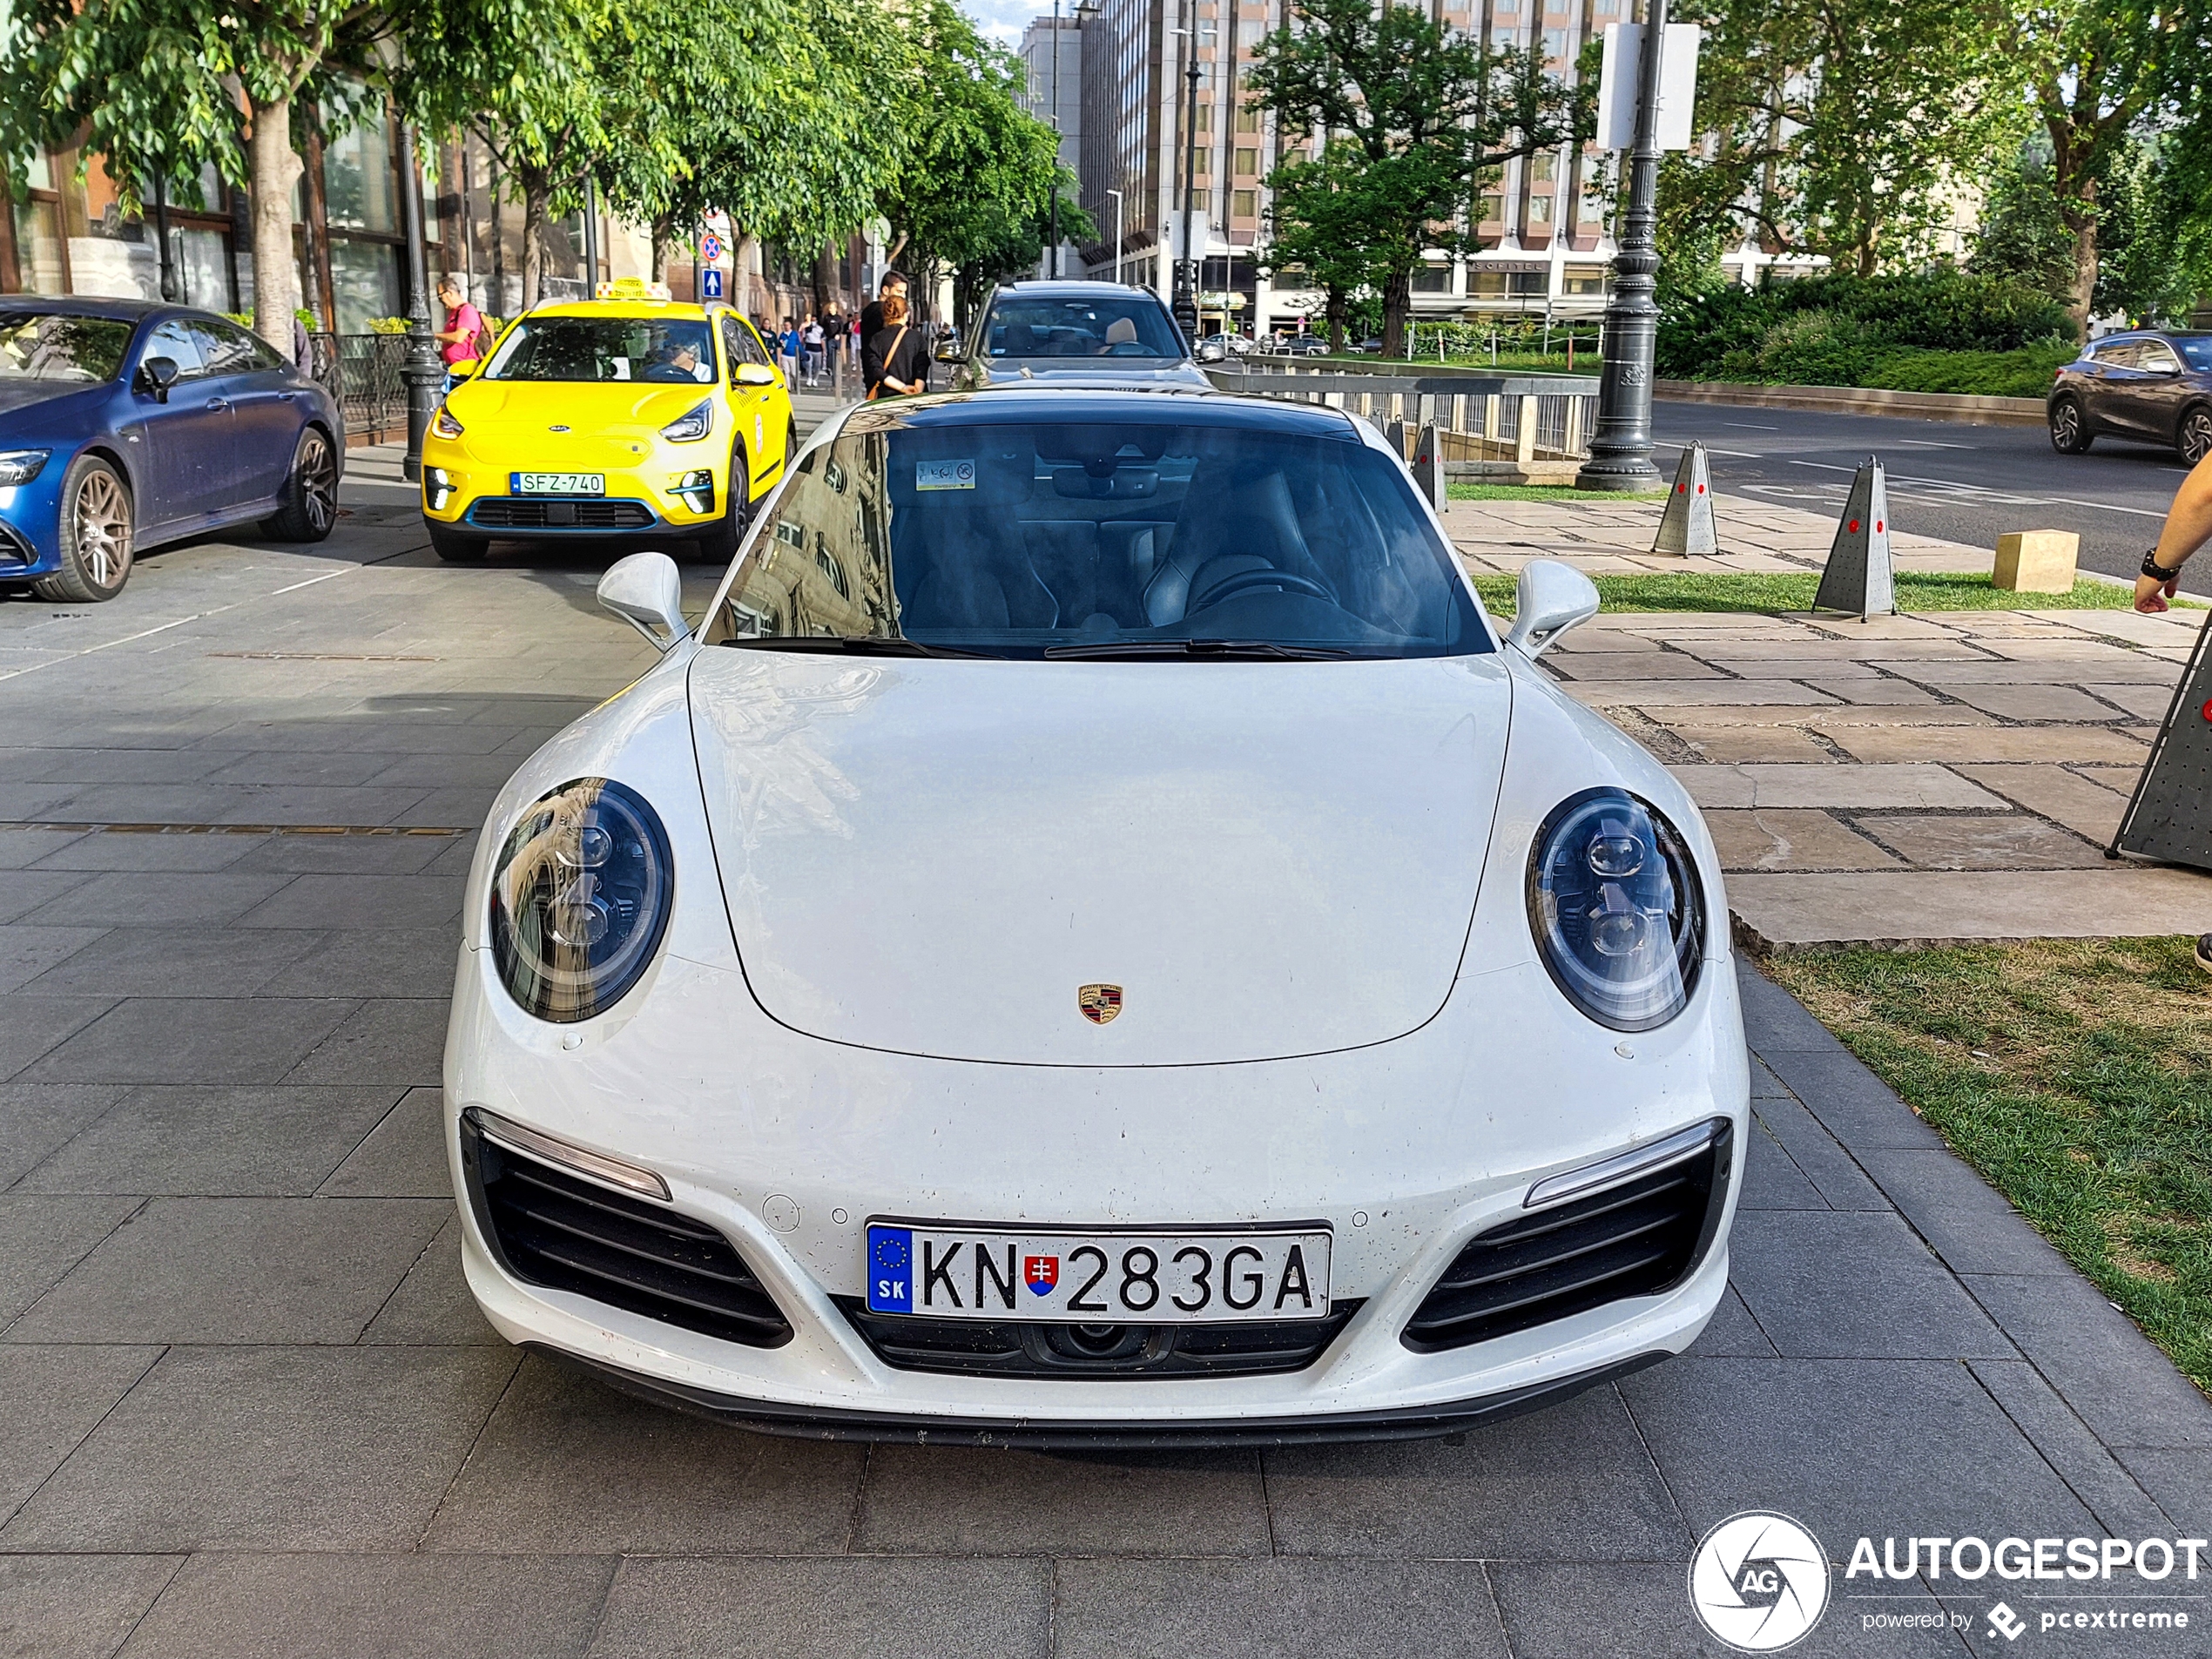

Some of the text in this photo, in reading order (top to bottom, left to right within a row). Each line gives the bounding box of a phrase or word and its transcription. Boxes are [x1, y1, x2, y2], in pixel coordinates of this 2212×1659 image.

[1474, 262, 1543, 271] SOFITEL
[524, 475, 599, 491] SFZ-740
[923, 1240, 1313, 1312] KN 283GA
[879, 1280, 905, 1299] SK
